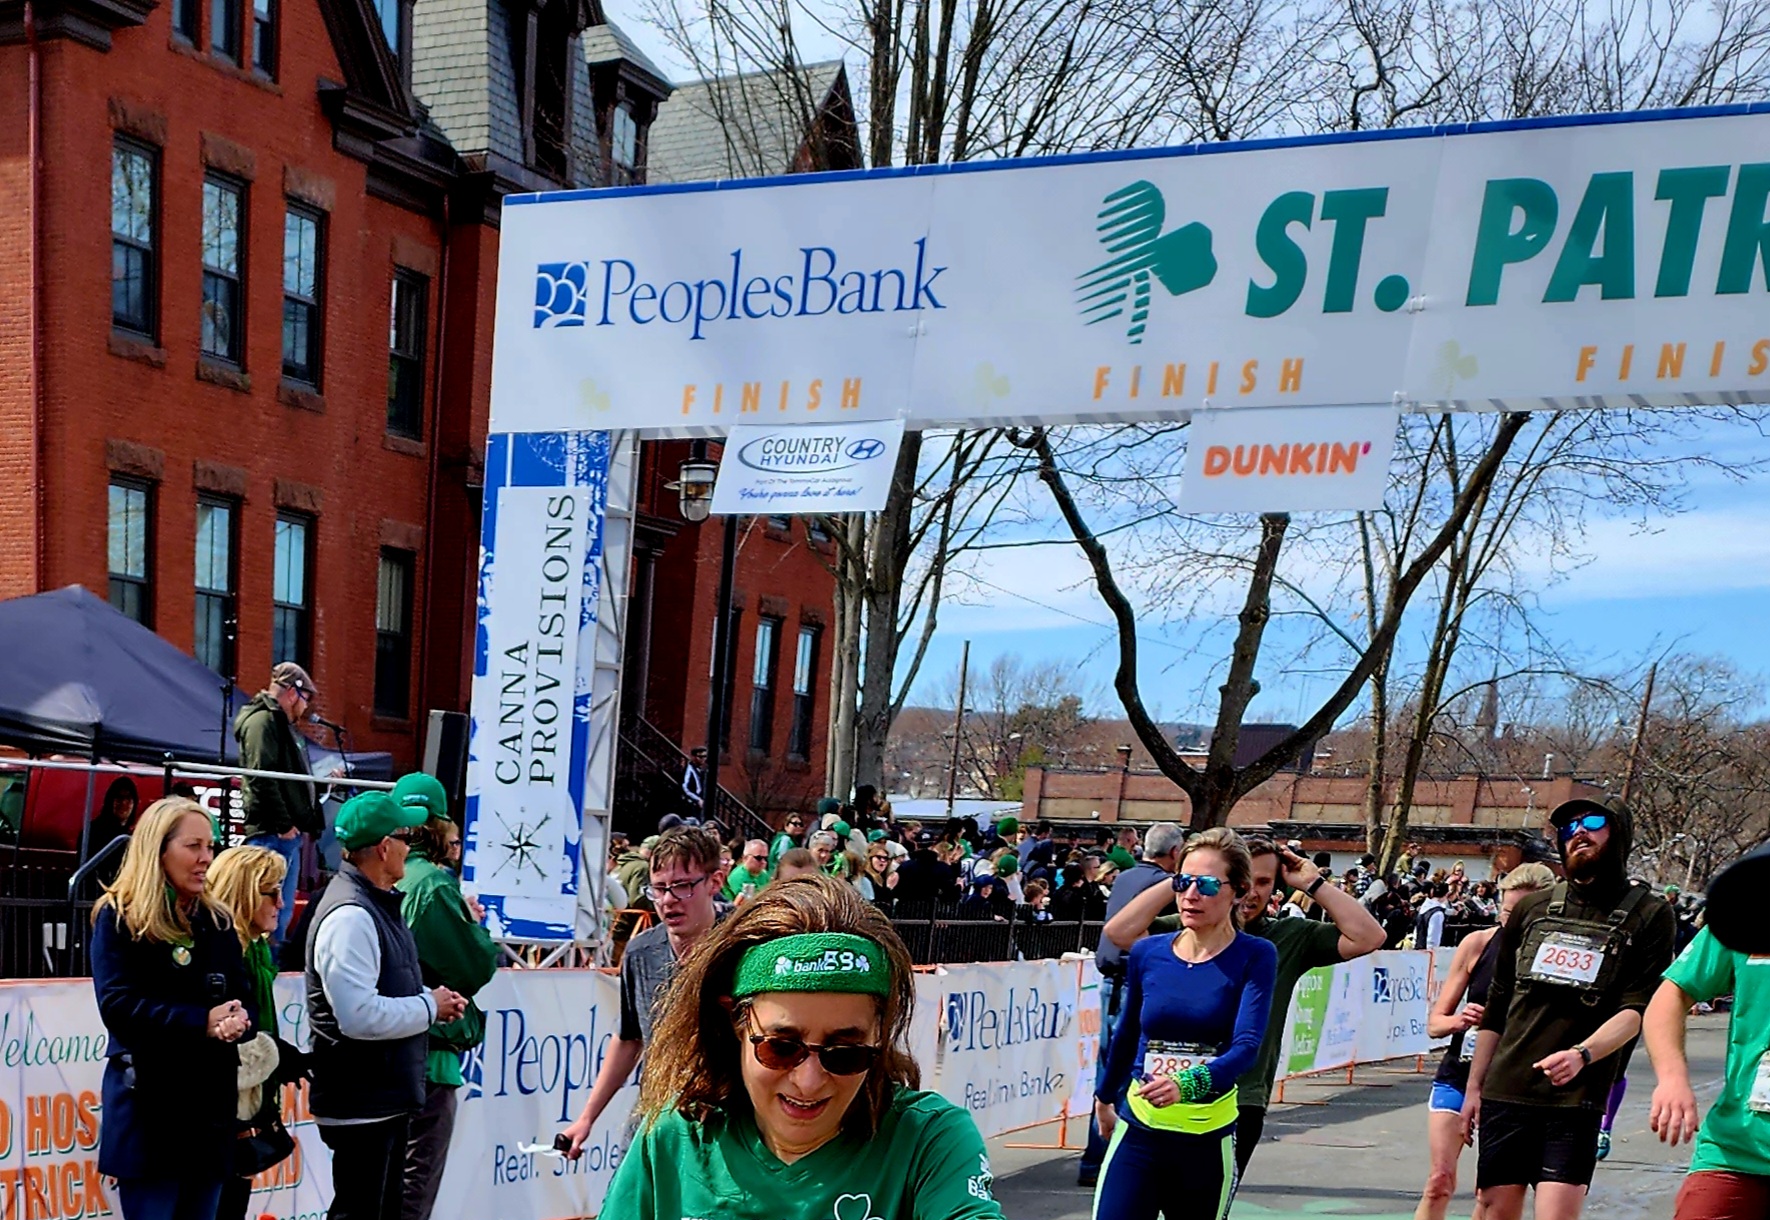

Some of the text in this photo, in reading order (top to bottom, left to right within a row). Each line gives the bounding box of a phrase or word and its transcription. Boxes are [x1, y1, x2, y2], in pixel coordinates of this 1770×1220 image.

[1245, 186, 1410, 318] ST.
[596, 237, 949, 340] PeoplesBank
[681, 377, 863, 414] FINISH
[1093, 358, 1305, 399] FINISH
[760, 453, 838, 466] HYUNDAI
[762, 436, 846, 455] COUNTRY
[1203, 441, 1371, 477] DUNKIN'
[528, 494, 576, 787] PROVISIONS
[495, 640, 529, 786] CANNA
[1541, 946, 1595, 971] 2633
[26, 1090, 103, 1157] HOS
